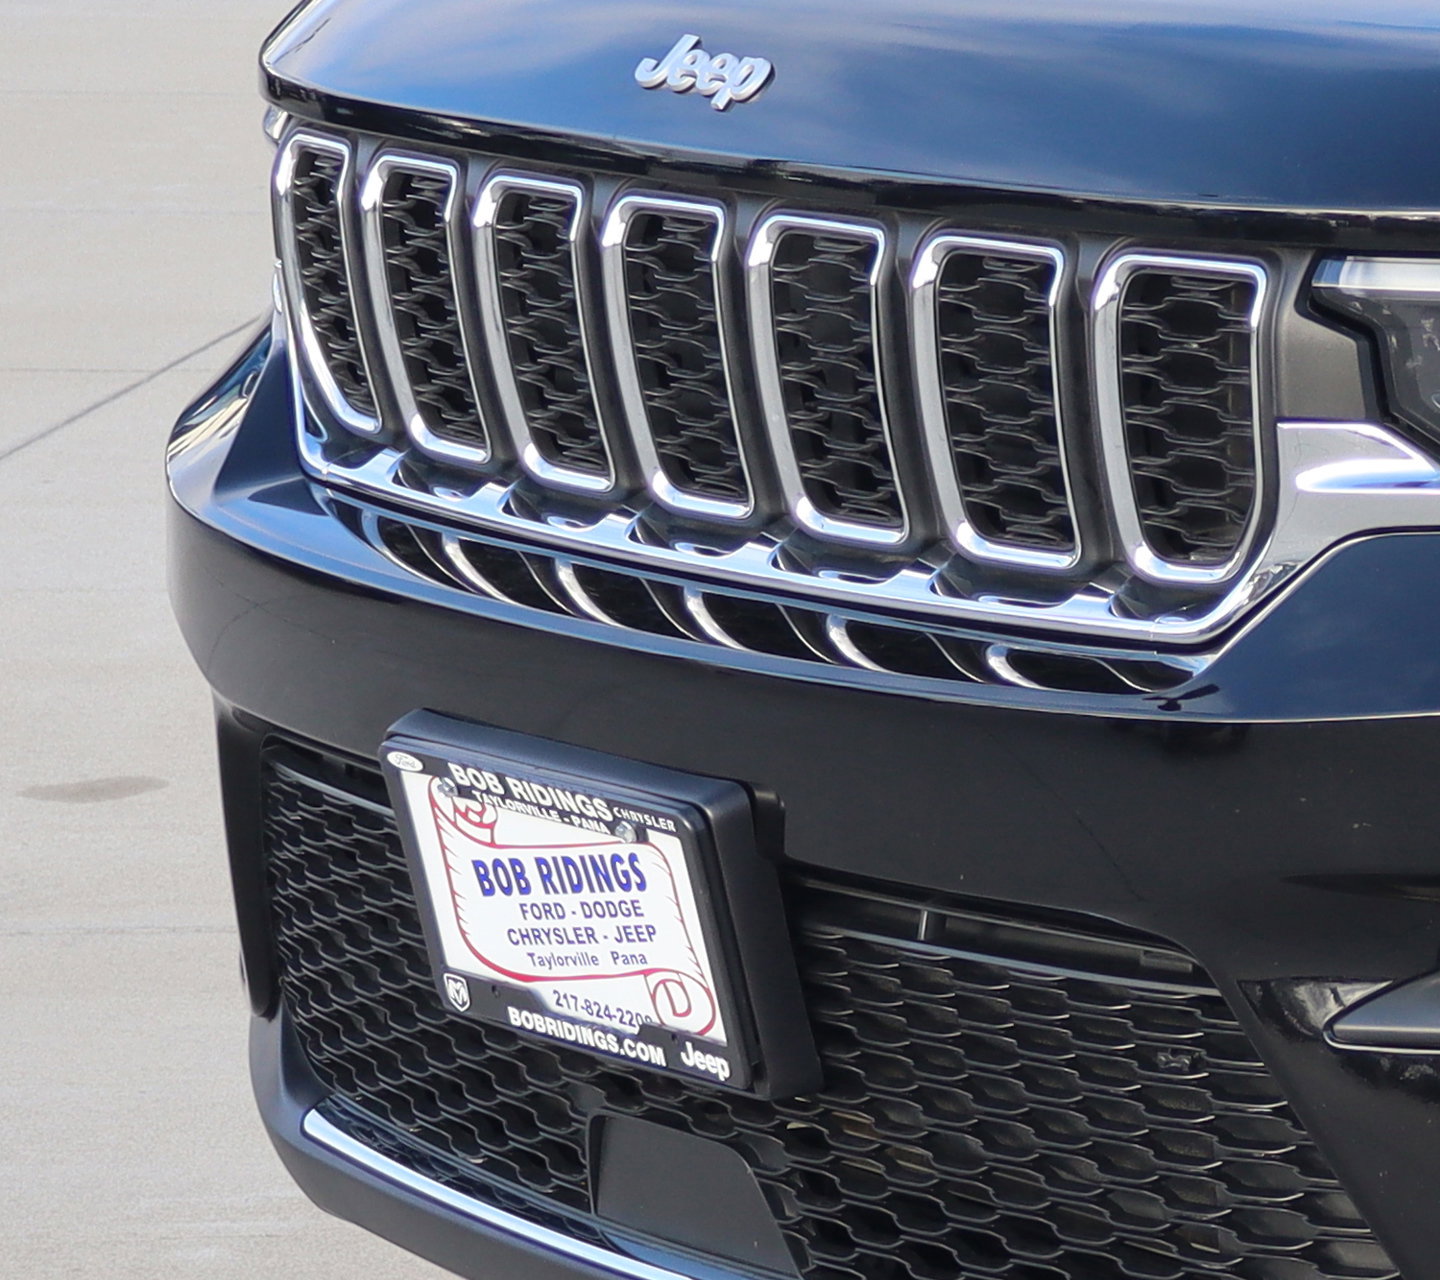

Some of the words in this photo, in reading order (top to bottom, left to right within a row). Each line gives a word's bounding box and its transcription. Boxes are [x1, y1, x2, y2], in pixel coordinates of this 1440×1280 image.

[634, 34, 774, 111] Jeep
[447, 762, 505, 795] BOB
[505, 777, 614, 823] RIDINGS
[472, 791, 561, 823] TAYLORVILLE
[571, 814, 612, 835] PANA
[613, 806, 677, 833] CHRYSLER
[471, 856, 532, 897] BOB
[534, 852, 648, 896] RIDINGS
[519, 901, 566, 921] FORD
[580, 899, 645, 920] DODGE
[507, 926, 600, 946] CHRYSLER
[614, 924, 657, 944] JEEP
[526, 951, 600, 970] Taylorville
[610, 950, 648, 966] Pana
[507, 1006, 667, 1067] BOBRIDINGS.COM
[680, 1041, 731, 1082] Jeep
